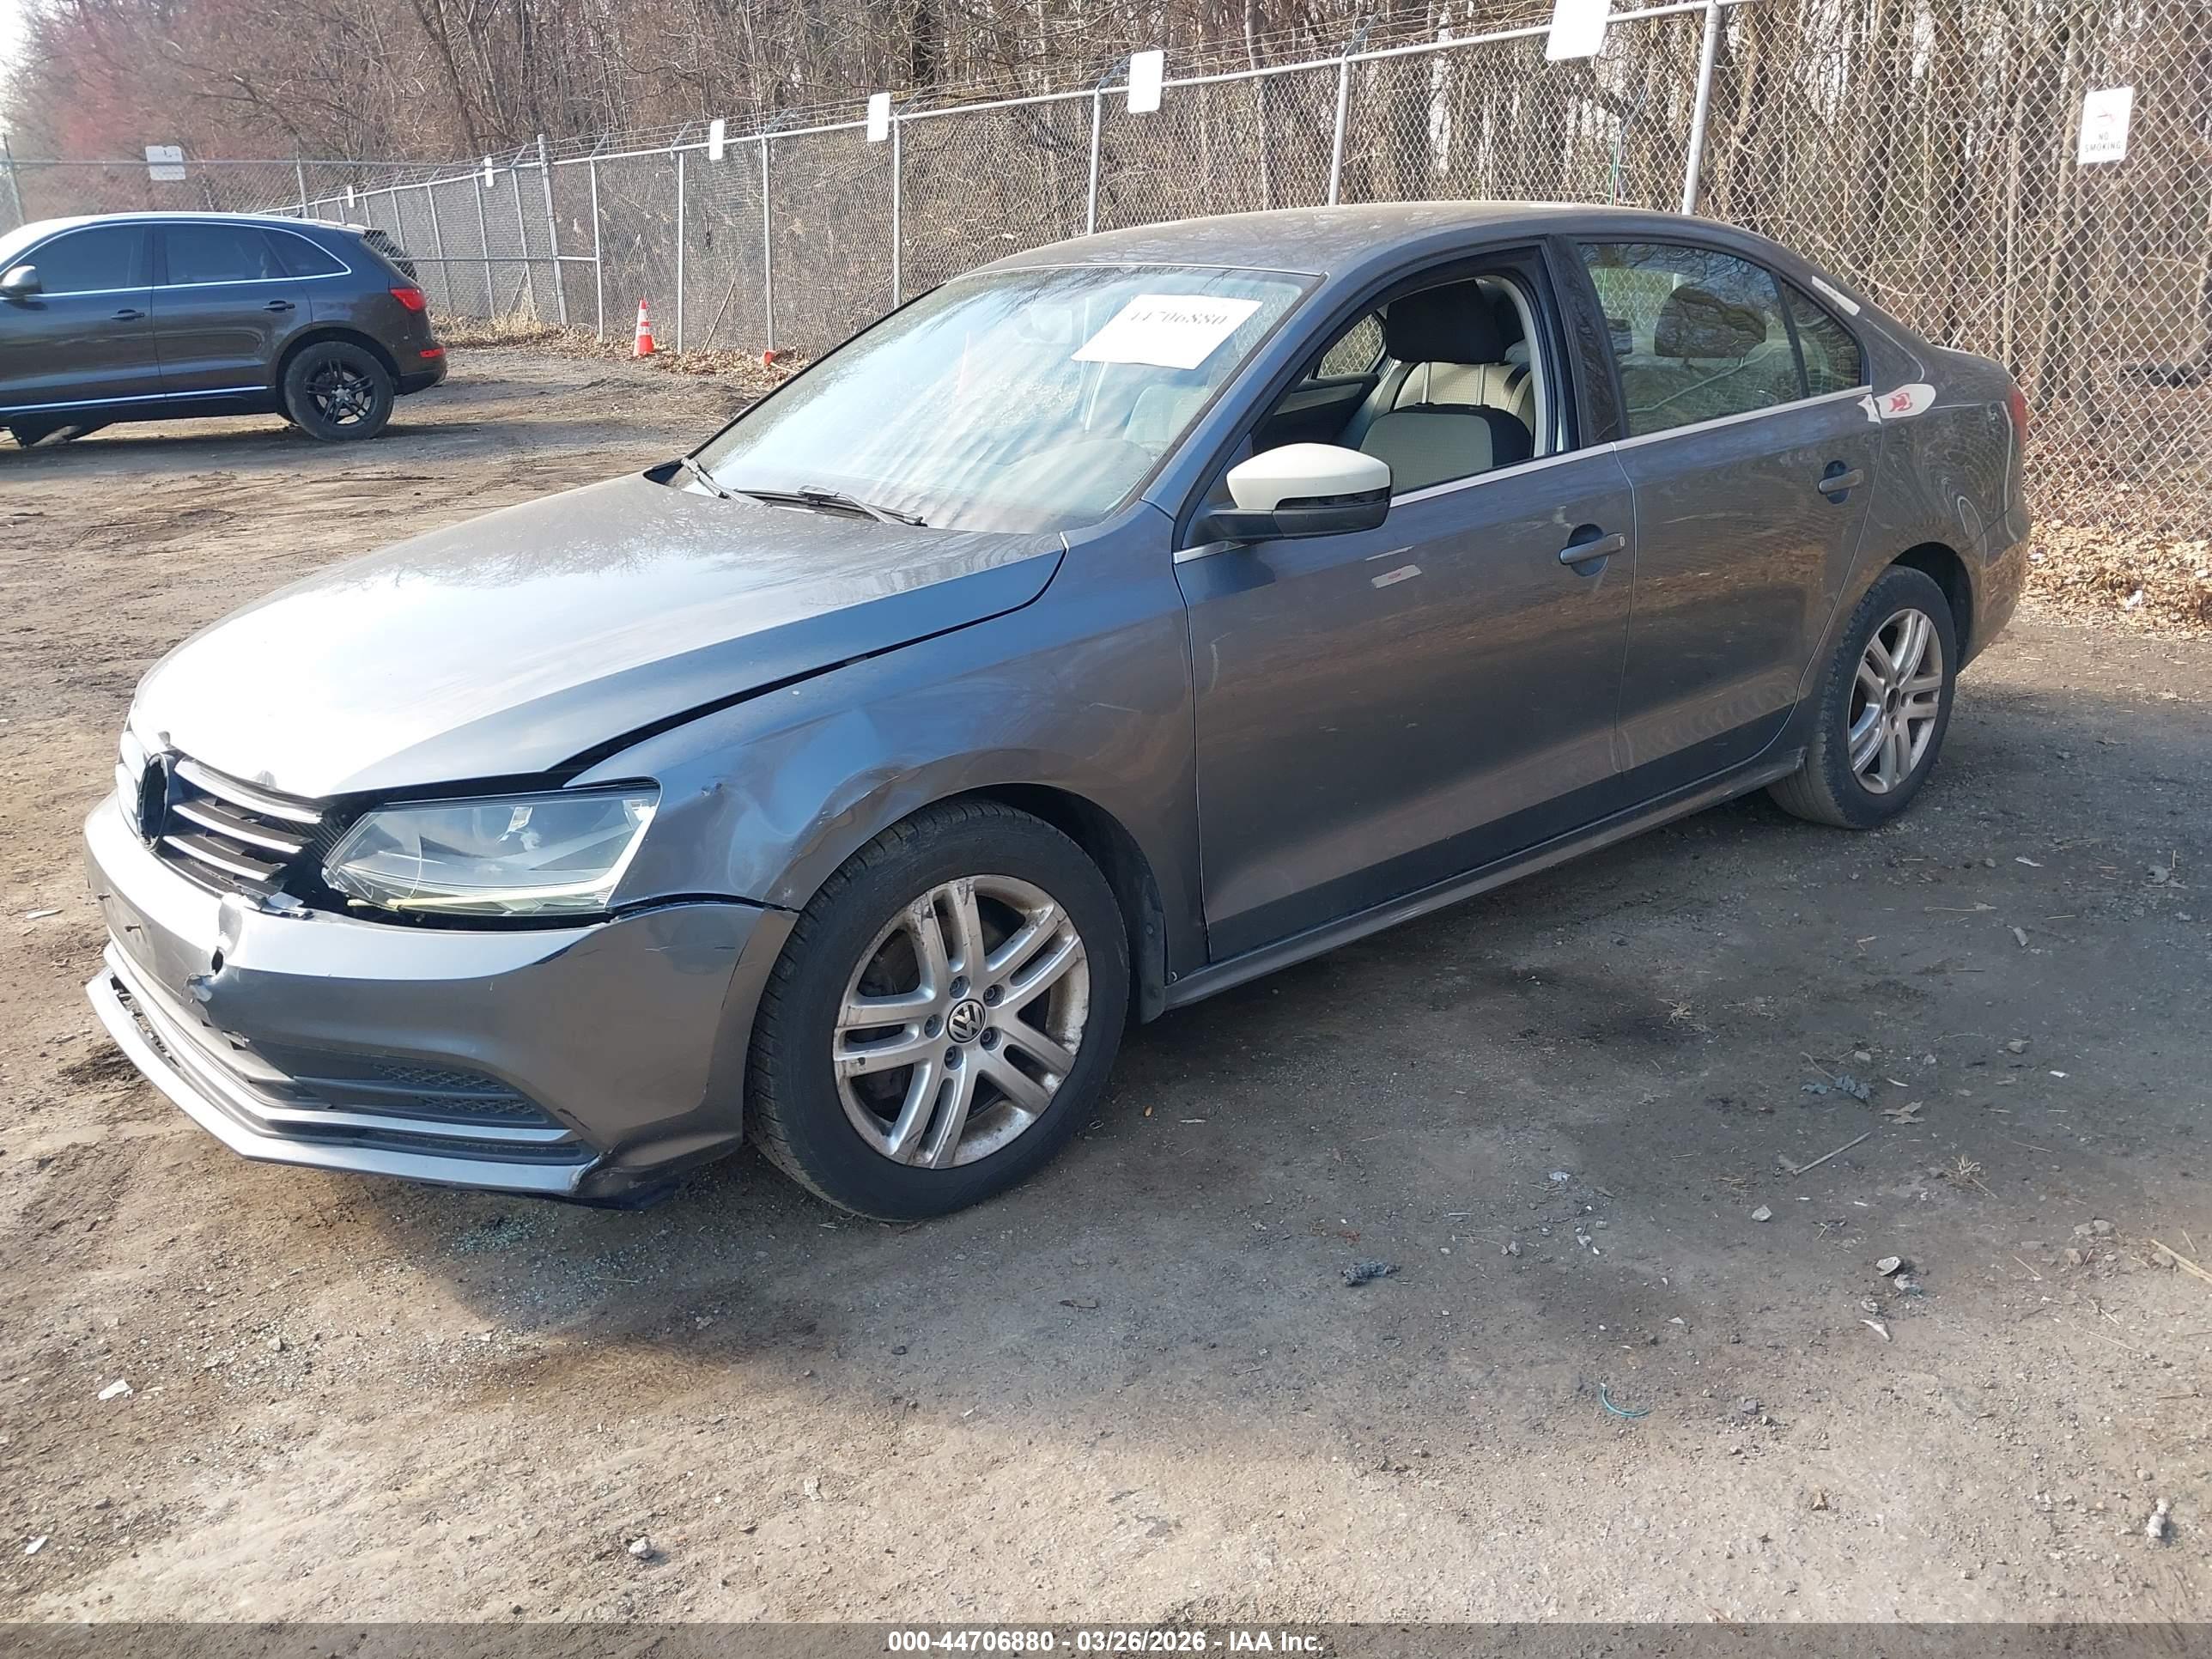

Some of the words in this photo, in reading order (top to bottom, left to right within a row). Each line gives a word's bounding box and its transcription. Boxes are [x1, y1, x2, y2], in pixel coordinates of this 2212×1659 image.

[2099, 131, 2109, 141] NO
[2085, 141, 2121, 153] SMOKING
[949, 1000, 985, 1042] VW
